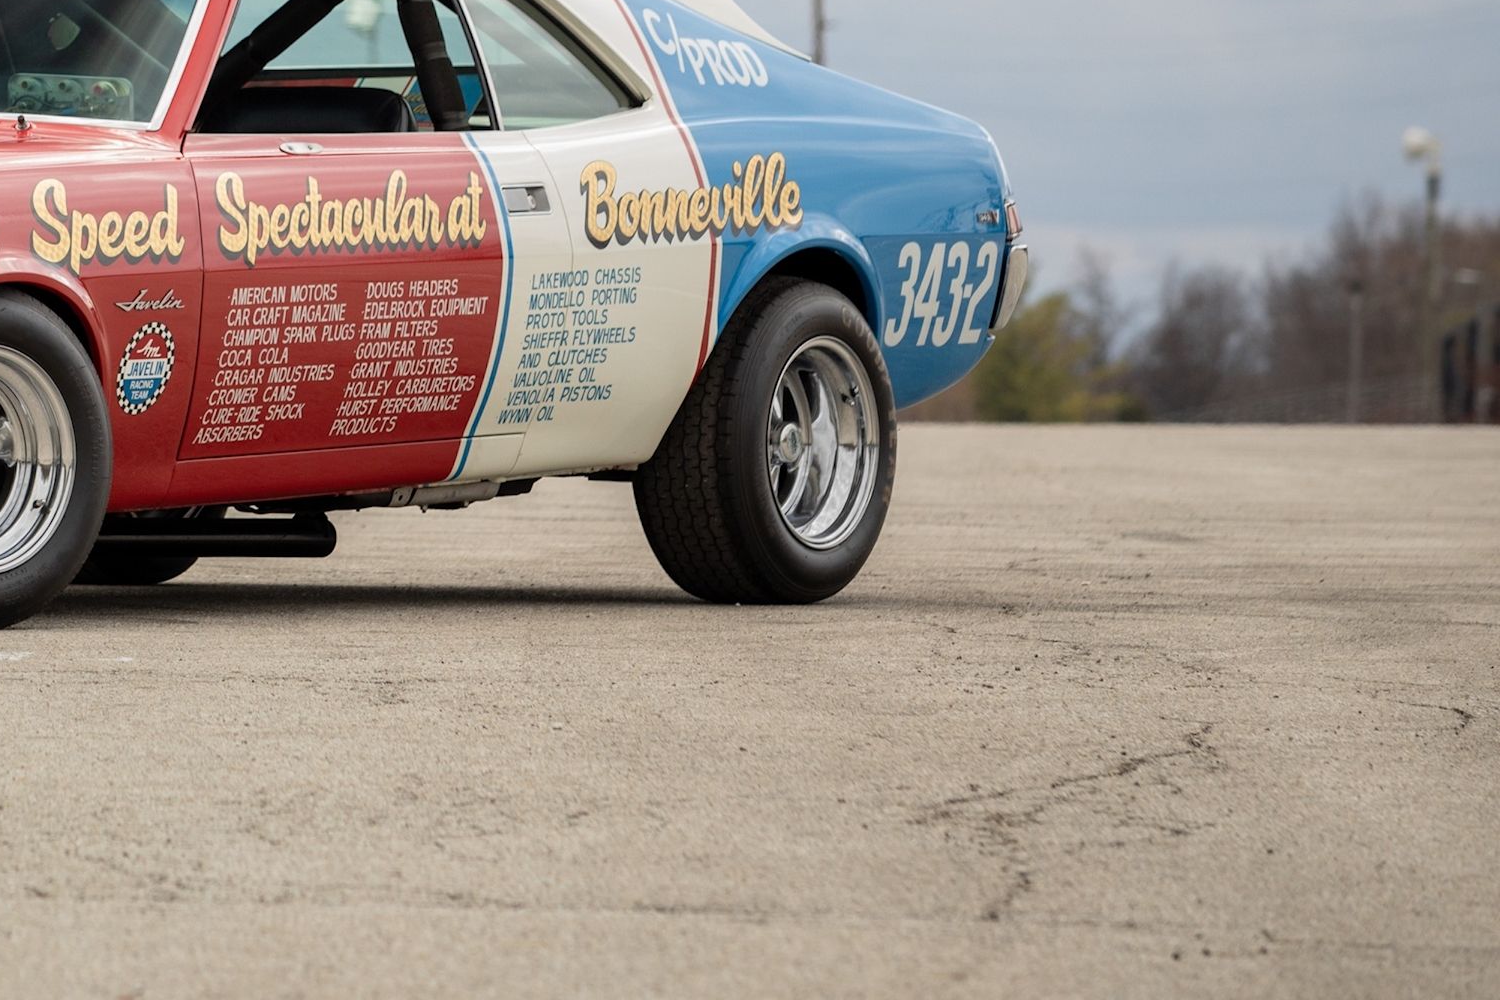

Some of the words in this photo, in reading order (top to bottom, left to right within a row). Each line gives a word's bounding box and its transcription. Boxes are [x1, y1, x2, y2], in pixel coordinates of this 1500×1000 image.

[642, 8, 768, 87] C/PROD
[32, 178, 185, 275] Speed
[216, 169, 445, 268] Spectacular
[445, 171, 487, 243] at
[580, 152, 803, 246] Bonneville
[367, 281, 404, 300] DOUGS
[409, 279, 458, 297] HEADERS
[531, 270, 589, 290] LAKEWOOD
[594, 267, 642, 285] CHASSIS
[115, 289, 185, 312] Javelin
[230, 286, 286, 305] AMERICAN
[290, 283, 338, 302] MOTORS
[528, 290, 584, 310] MONDELLO
[591, 287, 637, 306] PORTING
[884, 241, 998, 347] 343-2
[227, 308, 250, 327] CAR
[252, 306, 289, 325] CRAFT
[291, 304, 347, 323] MAGAZINE
[363, 300, 425, 320] EDELBROCK
[430, 297, 488, 317] EQUIPMENT
[525, 312, 565, 330] PROTO
[572, 309, 608, 326] TOOLS
[223, 327, 280, 347] CHAMPION
[282, 325, 317, 343] SPARK
[321, 323, 356, 342] PLUGS
[359, 322, 391, 340] FRAM
[394, 320, 438, 338] FILTERS
[572, 326, 636, 346] FLYWHEELS
[218, 348, 252, 368] COCA
[258, 347, 289, 365] COLA
[355, 340, 415, 360] GOODYEAR
[421, 338, 454, 356] TIRES
[518, 353, 541, 370] AND
[547, 348, 608, 367] CLUTCHES
[127, 361, 165, 377] JAVELIN
[214, 368, 265, 387] CRAGAR
[267, 364, 335, 383] INDUSTRIES
[351, 361, 391, 379] GRANT
[393, 357, 458, 377] INDUSTRIES
[513, 368, 574, 388] VALVOLINE
[578, 367, 596, 383] OIL
[130, 379, 154, 390] RACING
[131, 390, 149, 400] TEAM
[208, 387, 258, 406] CROWER
[262, 385, 297, 403] CAMS
[344, 380, 392, 398] HOLLEY
[395, 375, 476, 396] CARBURETORS
[506, 387, 555, 407] VENOLIA
[559, 384, 612, 403] PISTONS
[202, 405, 263, 425] CURE-RIDE
[265, 403, 305, 421] SHOCK
[337, 399, 377, 417] HURST
[378, 394, 462, 415] PERFORMANCE
[497, 407, 532, 425] WYNN
[536, 406, 555, 422] OIL
[192, 424, 264, 444] ABSORBERS
[328, 416, 398, 436] PRODUCTS
